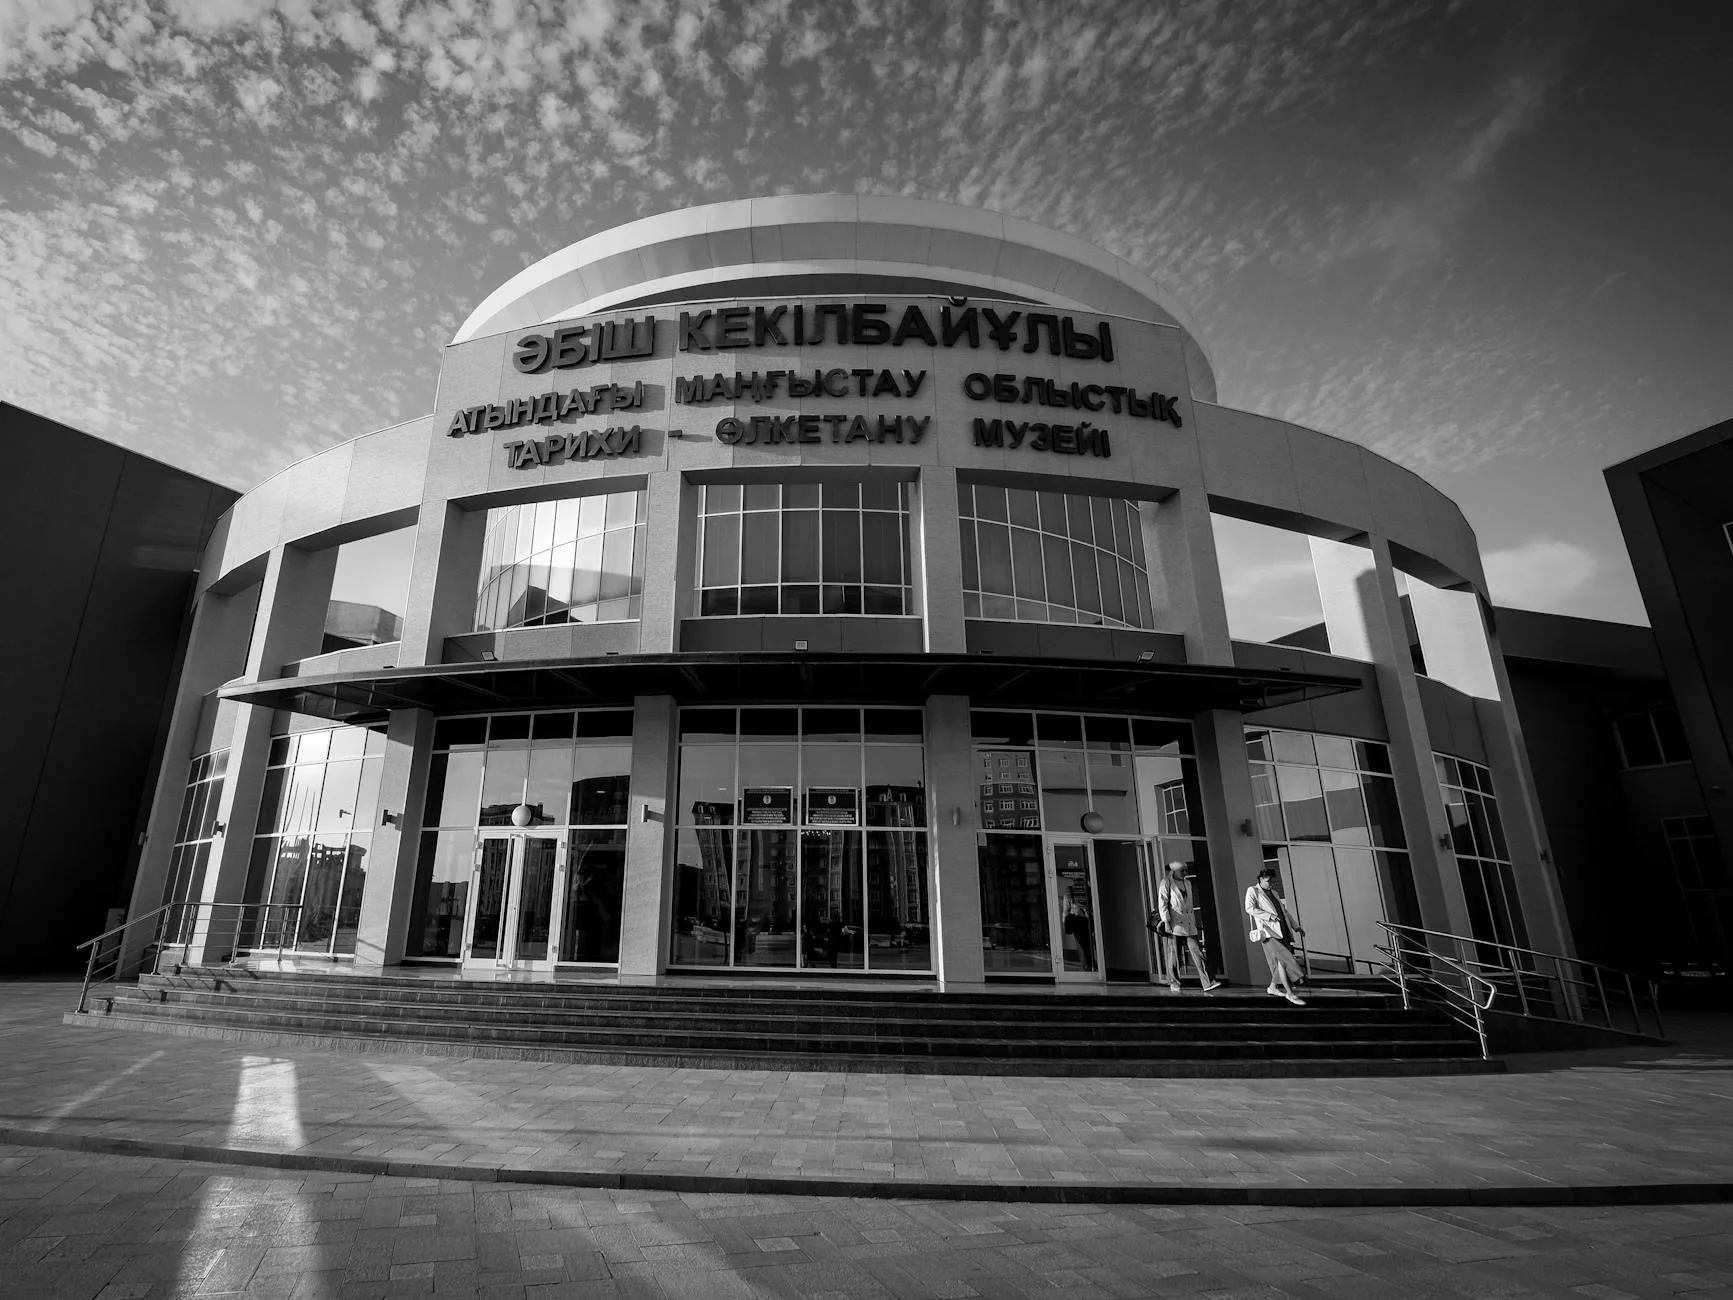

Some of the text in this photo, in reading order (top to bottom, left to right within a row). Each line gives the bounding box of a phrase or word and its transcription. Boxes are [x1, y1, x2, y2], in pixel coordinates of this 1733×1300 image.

[515, 295, 1114, 374] ӘБІШ КЕКІЛБАЙҰЛЫ
[447, 369, 1182, 436] АТЫНДАҒЫ МАҢҒЫСТАУ ОБЛЫСТЫҚ
[503, 424, 641, 469] ТАРИХИ
[715, 414, 931, 444] ӨЛКЕТАНУ
[973, 418, 1111, 458] МУЗЕЙІ
